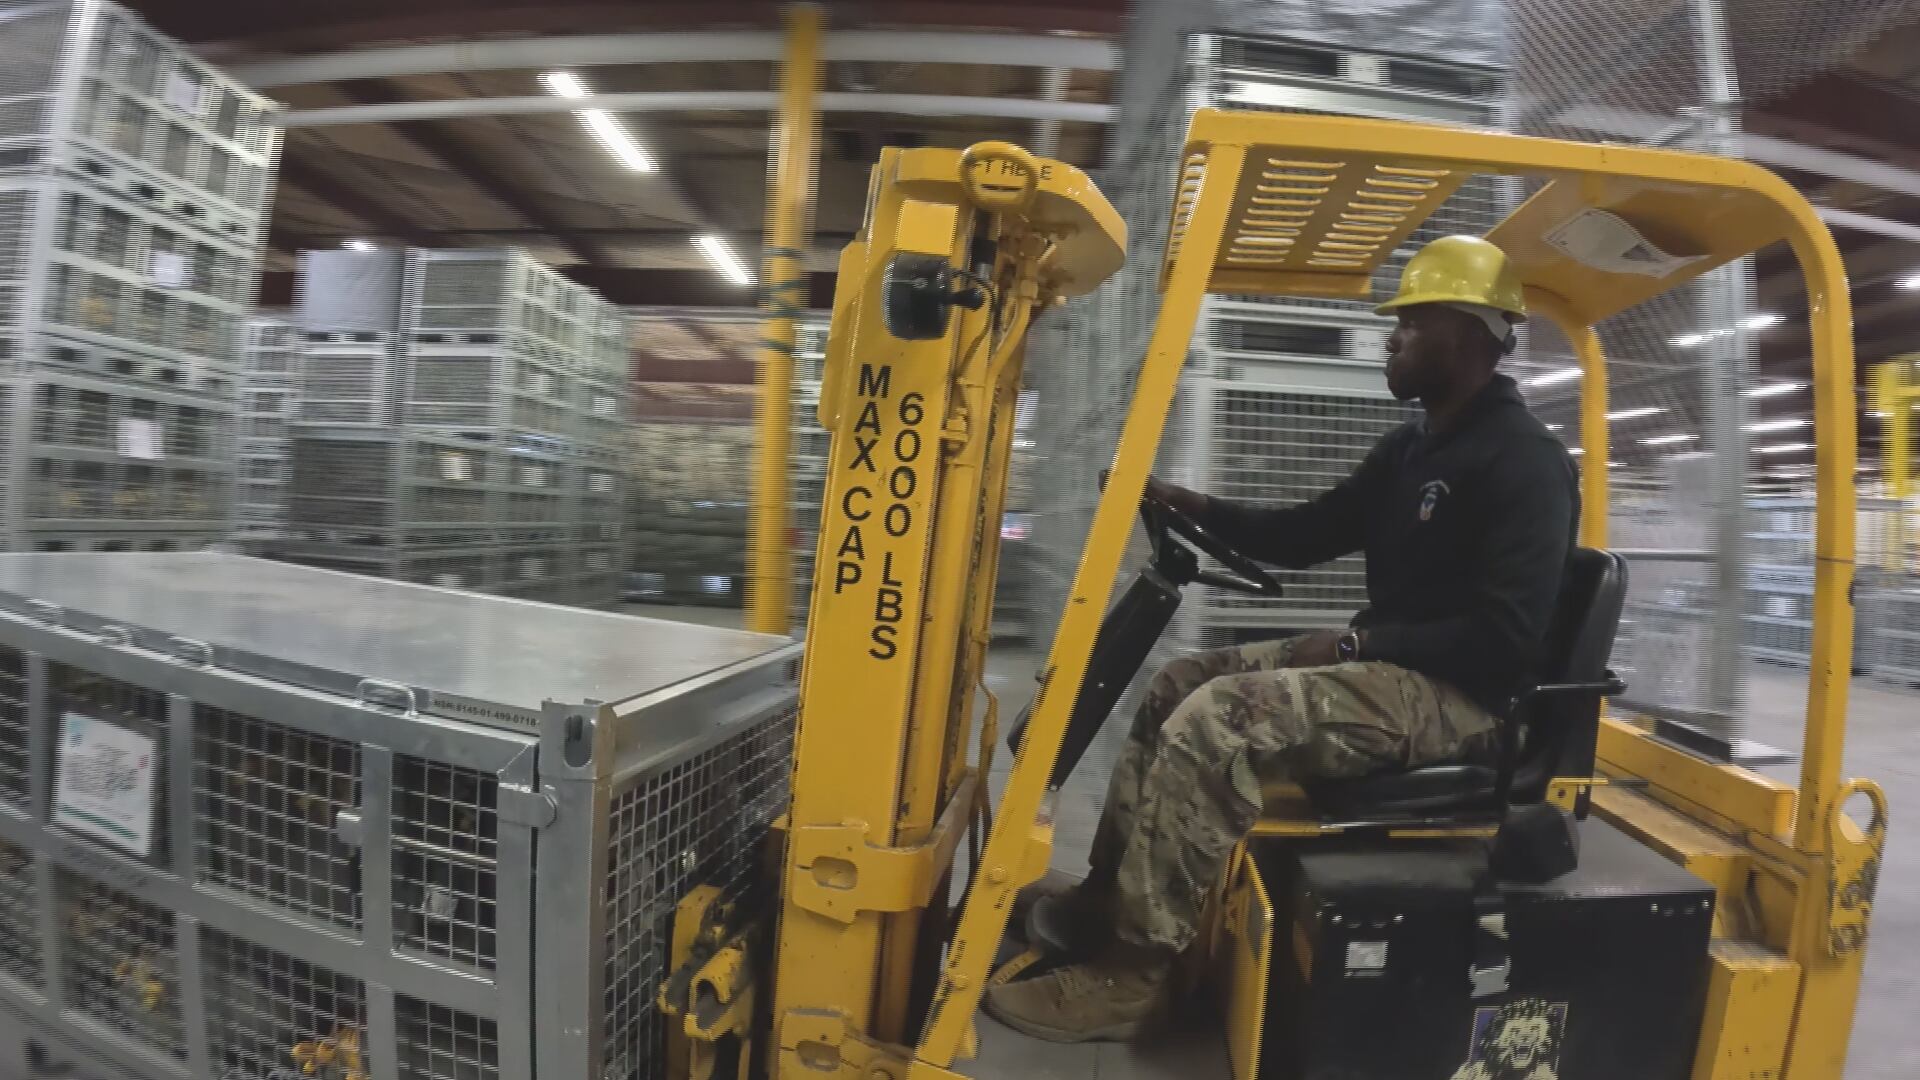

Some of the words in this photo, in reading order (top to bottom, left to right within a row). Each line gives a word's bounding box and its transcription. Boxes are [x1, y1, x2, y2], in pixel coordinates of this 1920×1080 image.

[1000, 159, 1053, 181] HEE
[848, 363, 892, 473] MAX
[884, 392, 925, 537] 6000
[834, 485, 873, 595] CAP
[868, 551, 903, 661] LBS
